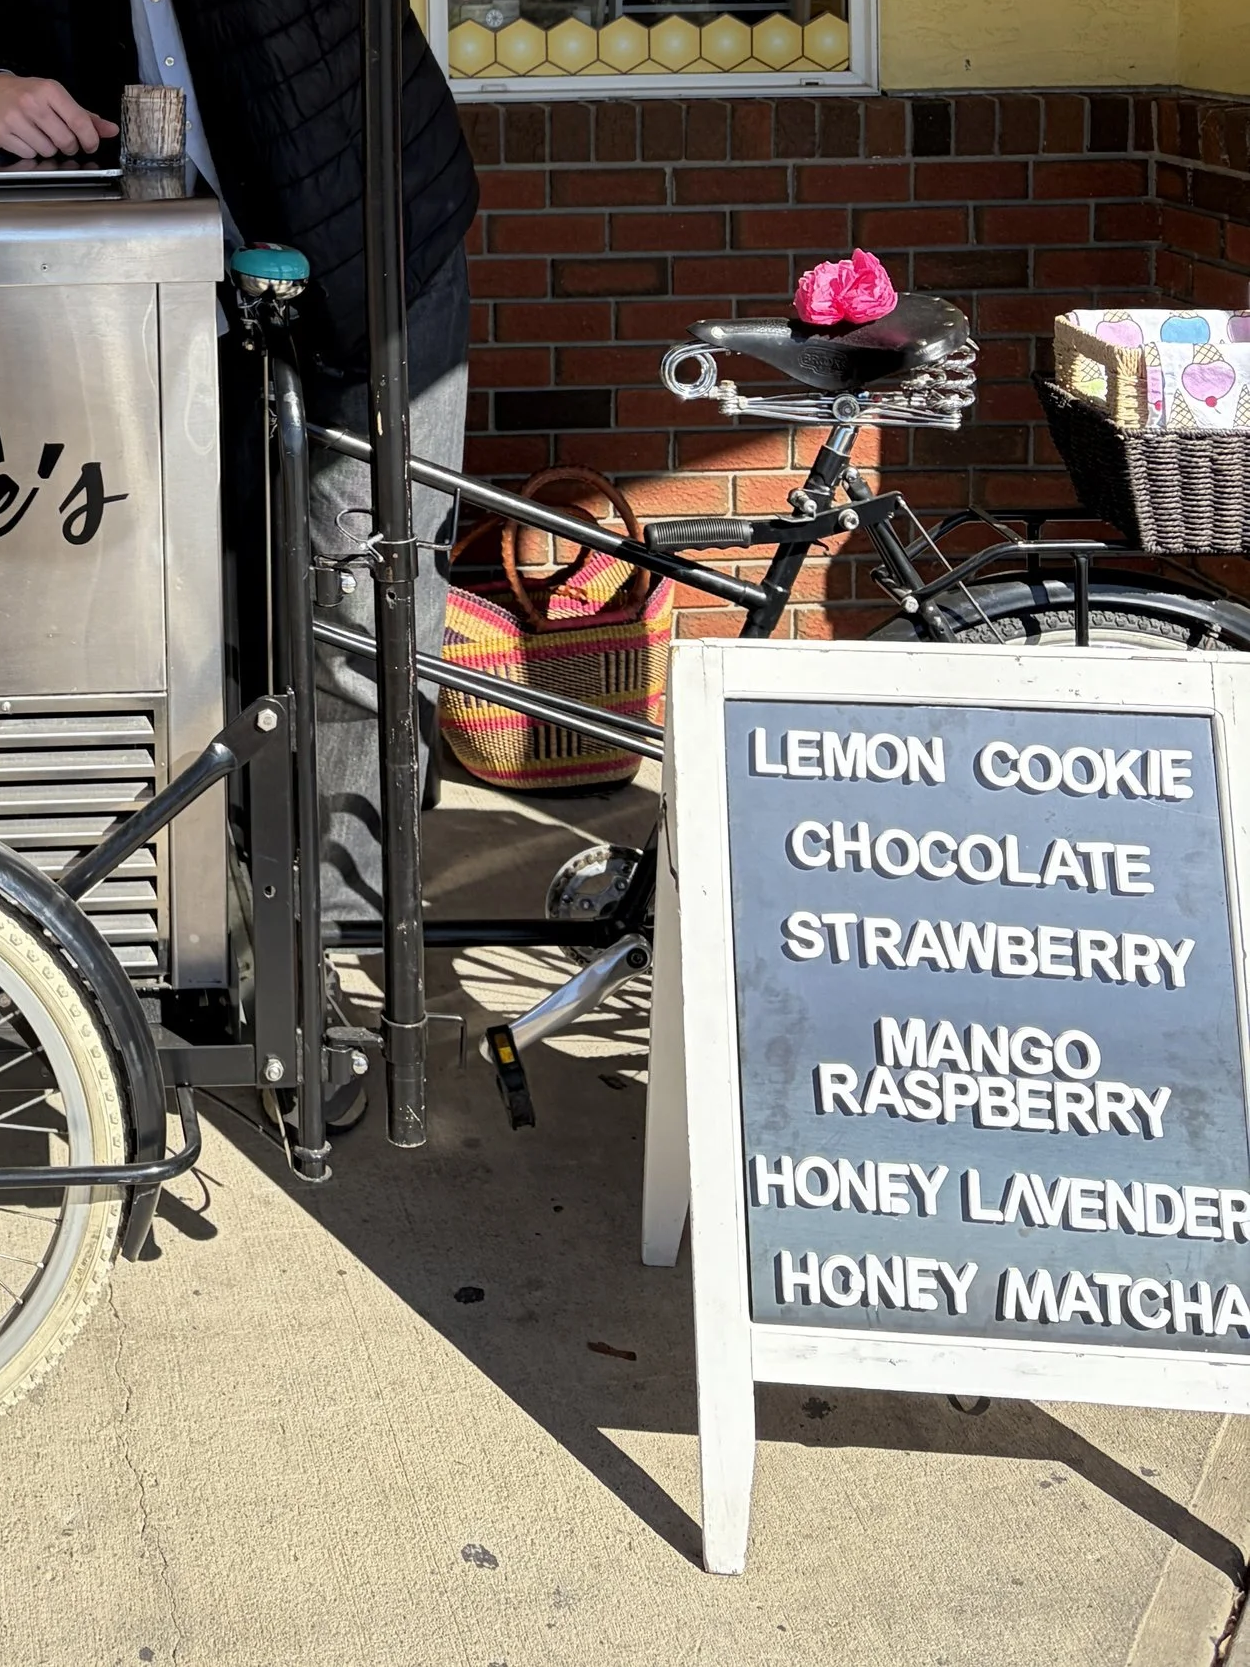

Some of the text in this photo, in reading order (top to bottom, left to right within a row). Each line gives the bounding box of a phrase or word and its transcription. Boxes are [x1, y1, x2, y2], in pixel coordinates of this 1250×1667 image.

[753, 727, 1194, 800] LEMON COOKIE
[790, 820, 1155, 894] CHOCOLATE
[784, 912, 1196, 988] STRAWBERRY
[879, 1016, 1101, 1080] MANGO
[817, 1063, 1172, 1138] RASPBERRY
[755, 1155, 1250, 1242] HONEY LAVENDER
[781, 1251, 1250, 1338] HONEY MATCHA
